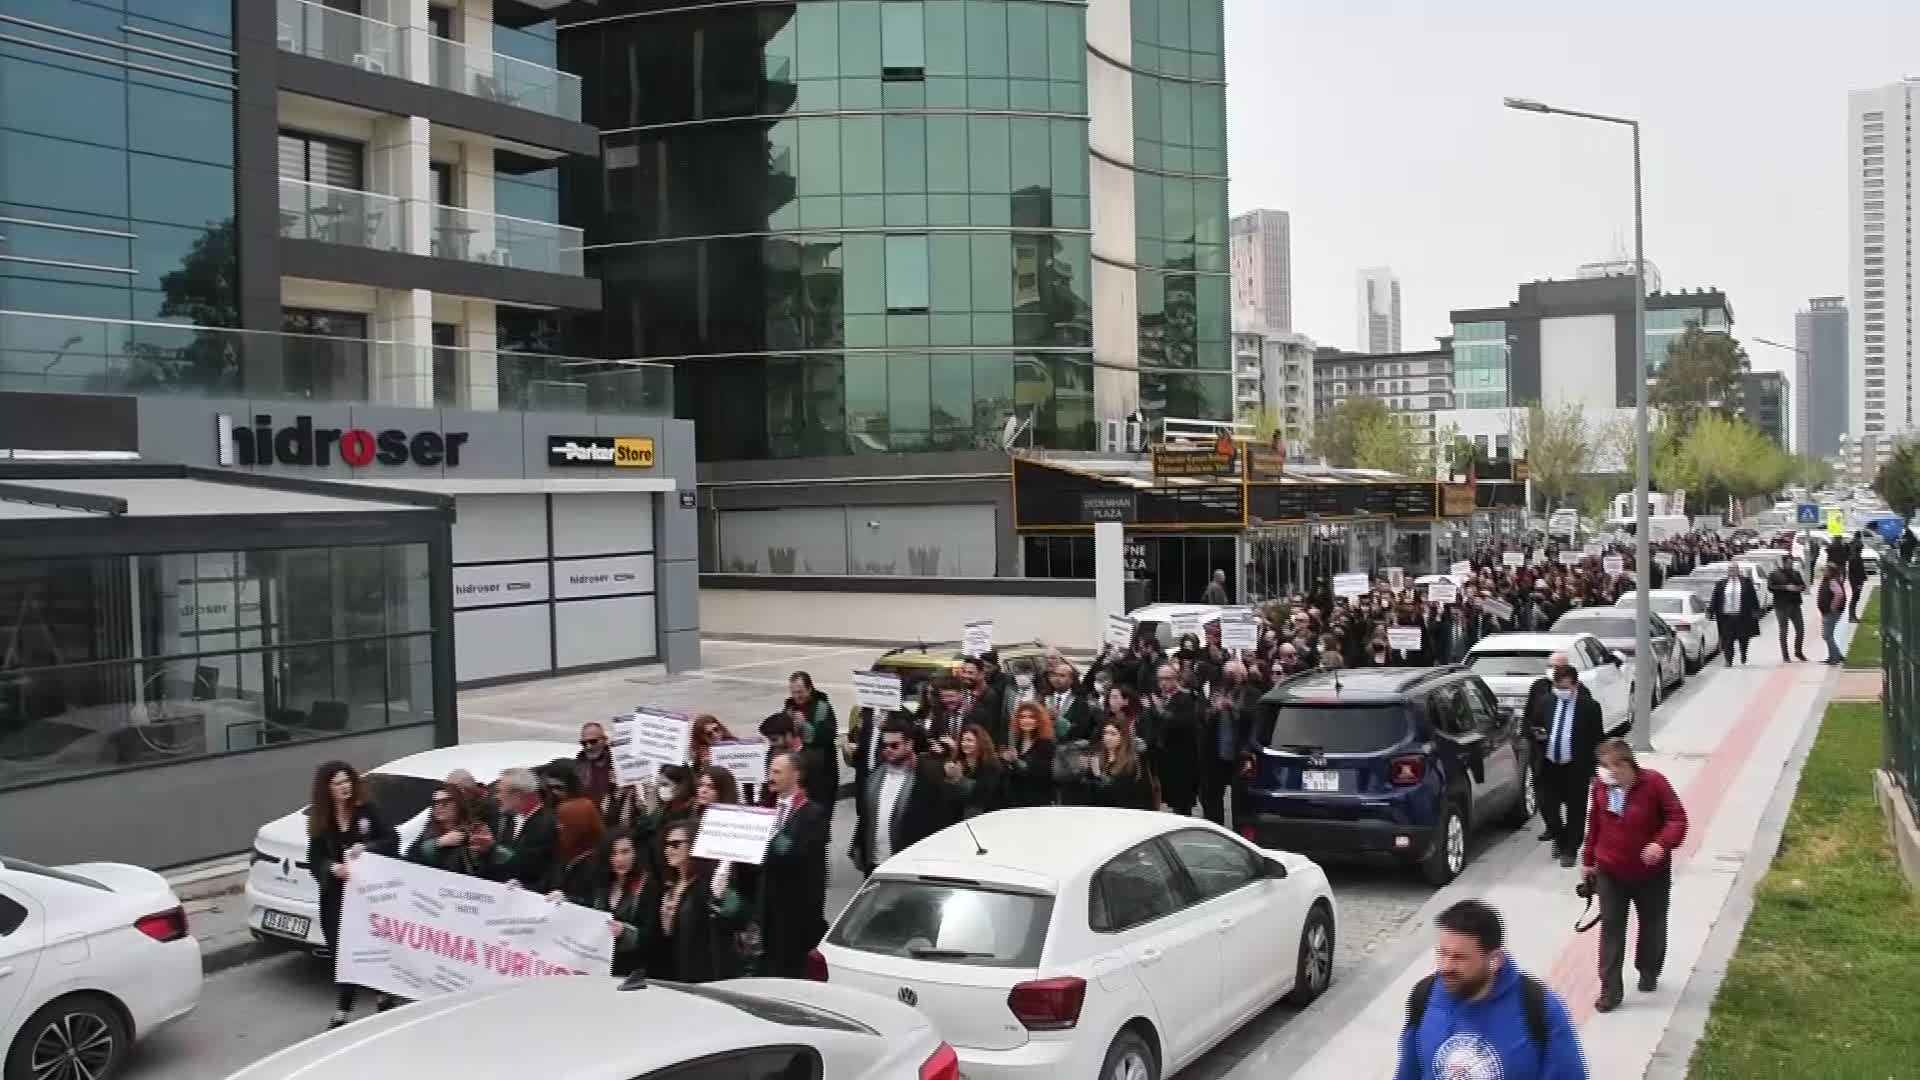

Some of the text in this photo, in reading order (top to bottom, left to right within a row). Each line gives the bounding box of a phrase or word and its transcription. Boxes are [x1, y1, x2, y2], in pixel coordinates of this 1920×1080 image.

[216, 413, 469, 467] hidroser
[617, 444, 652, 462] Store
[1123, 544, 1146, 556] FNE
[570, 574, 609, 584] hidroser
[455, 583, 500, 594] hidroser
[368, 911, 478, 965] SAVUNMA
